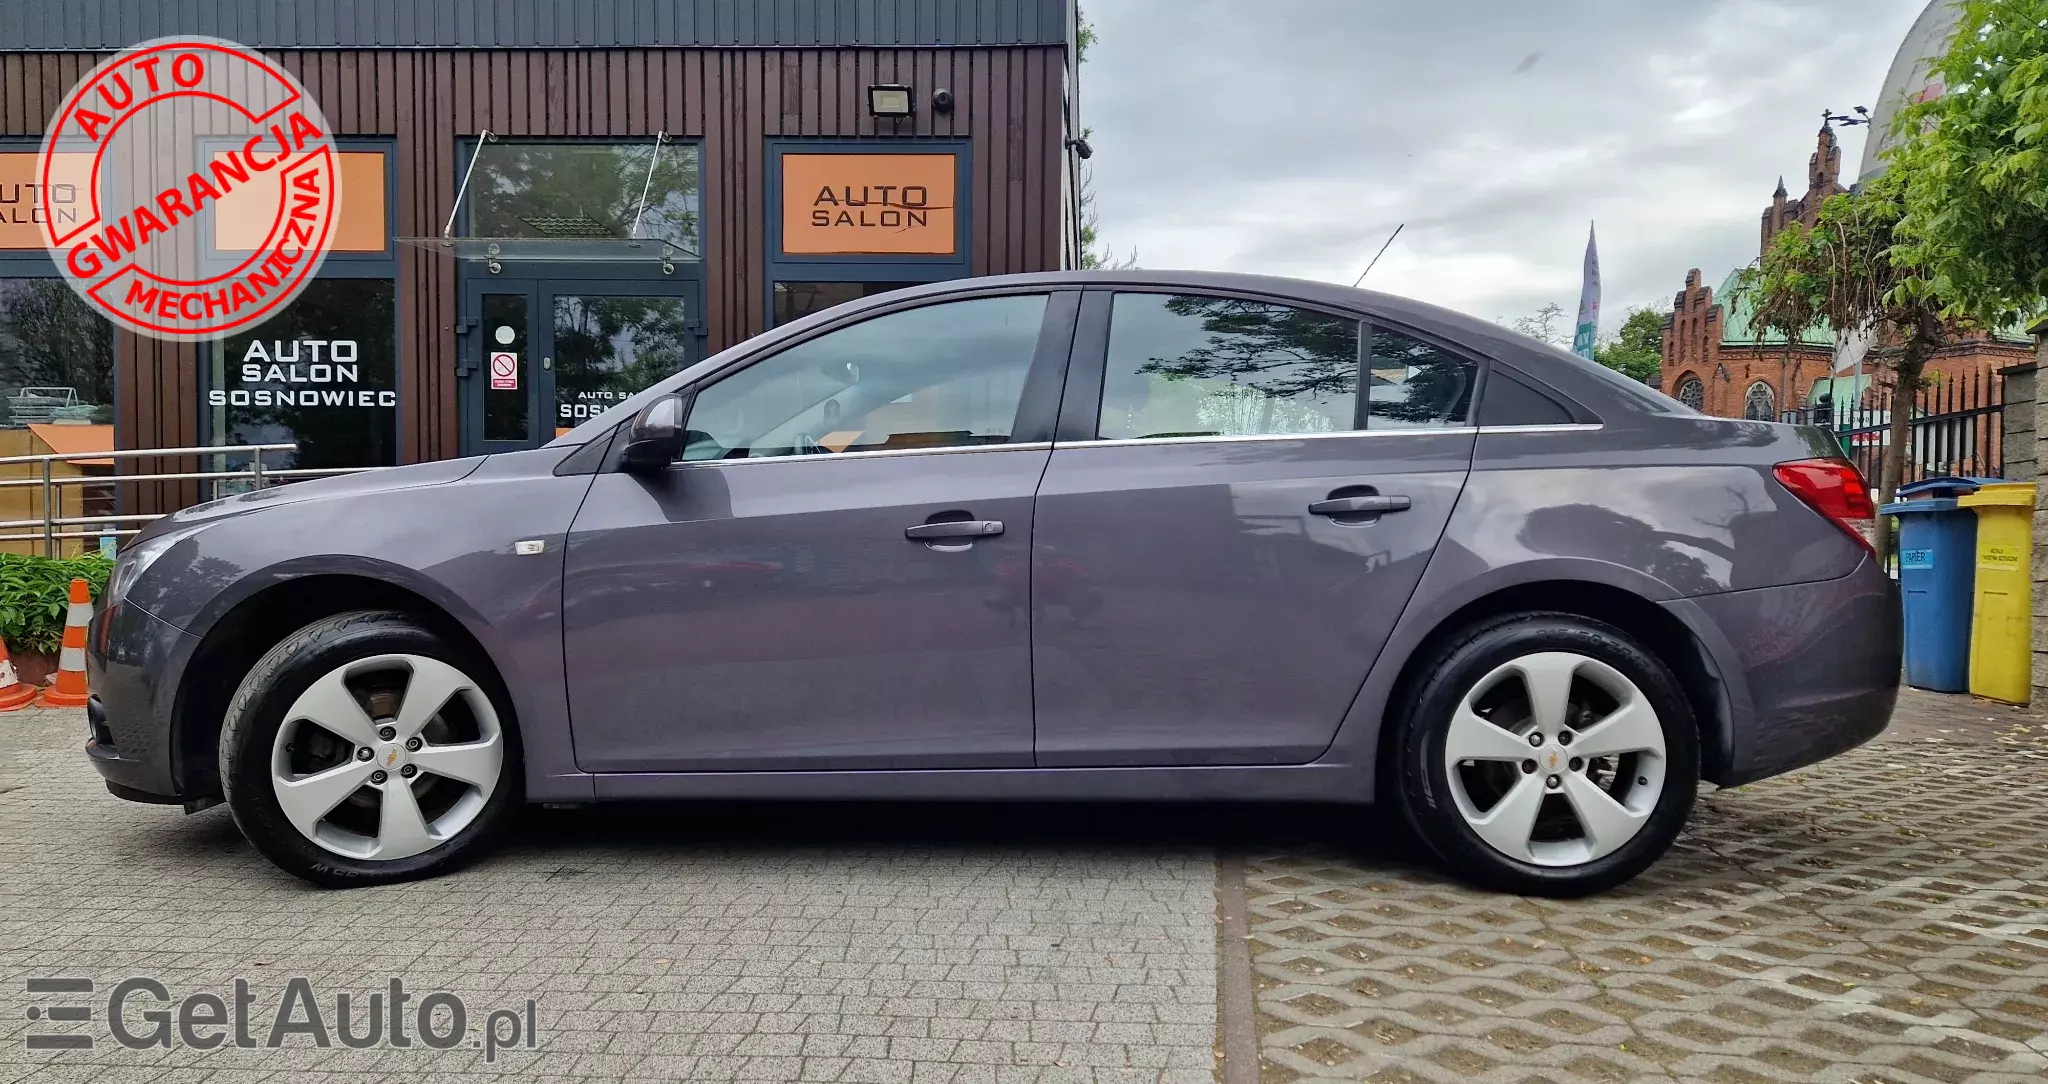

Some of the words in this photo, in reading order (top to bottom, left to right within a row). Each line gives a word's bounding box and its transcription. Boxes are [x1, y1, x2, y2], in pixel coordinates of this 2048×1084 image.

[0, 184, 76, 203] UTO
[813, 185, 927, 206] AUTO
[0, 208, 76, 223] LON
[812, 210, 926, 226] SALON
[243, 339, 358, 362] AUTO
[242, 364, 358, 382] SALON
[208, 390, 396, 407] SOSNOWIEC
[578, 391, 613, 399] AUTO
[618, 392, 638, 400] SA
[1905, 551, 1926, 562] PAPIER
